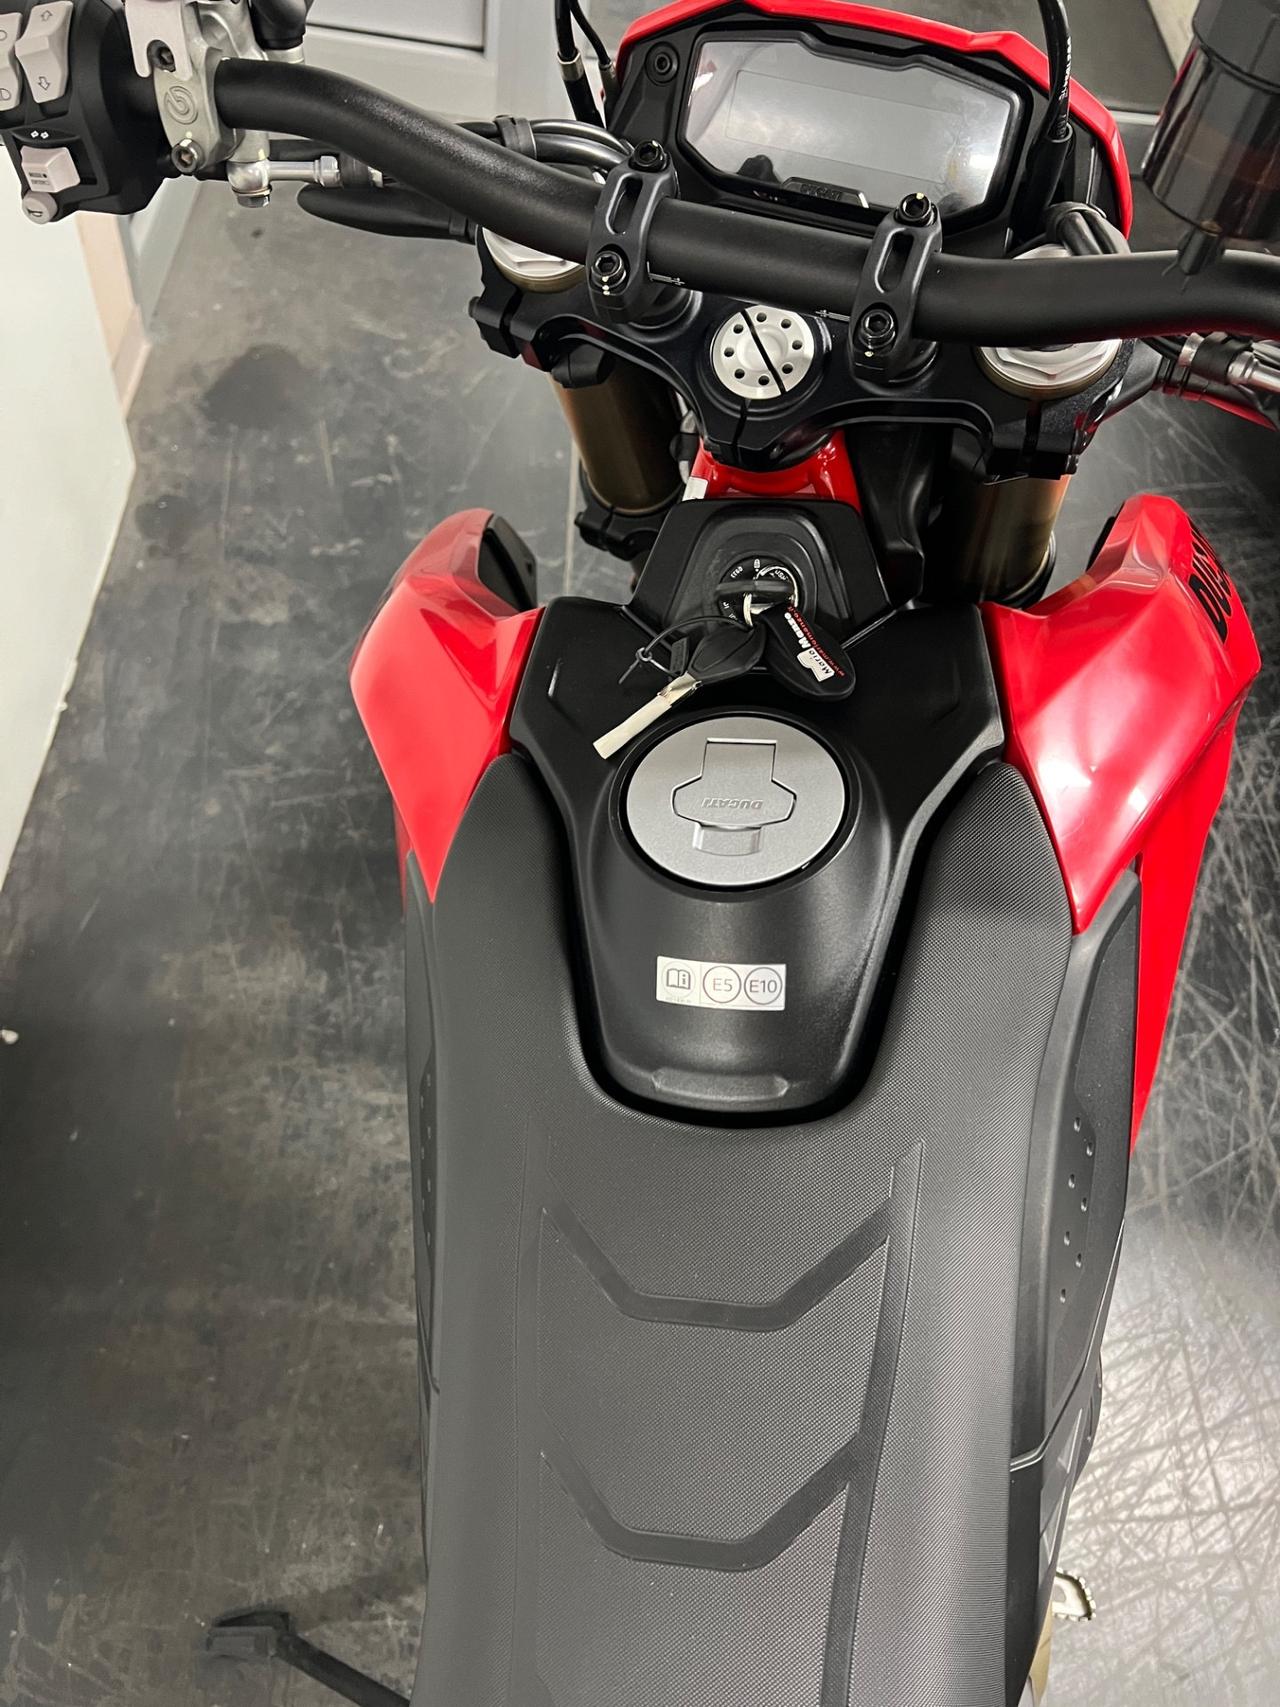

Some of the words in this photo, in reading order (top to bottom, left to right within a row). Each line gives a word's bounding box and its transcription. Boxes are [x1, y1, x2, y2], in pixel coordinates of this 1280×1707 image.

[1187, 515, 1233, 644] DUC
[784, 612, 811, 649] Manzo
[809, 649, 831, 674] Mario
[700, 797, 763, 809] DUCATI
[713, 978, 733, 992] E5
[749, 979, 777, 993] E10
